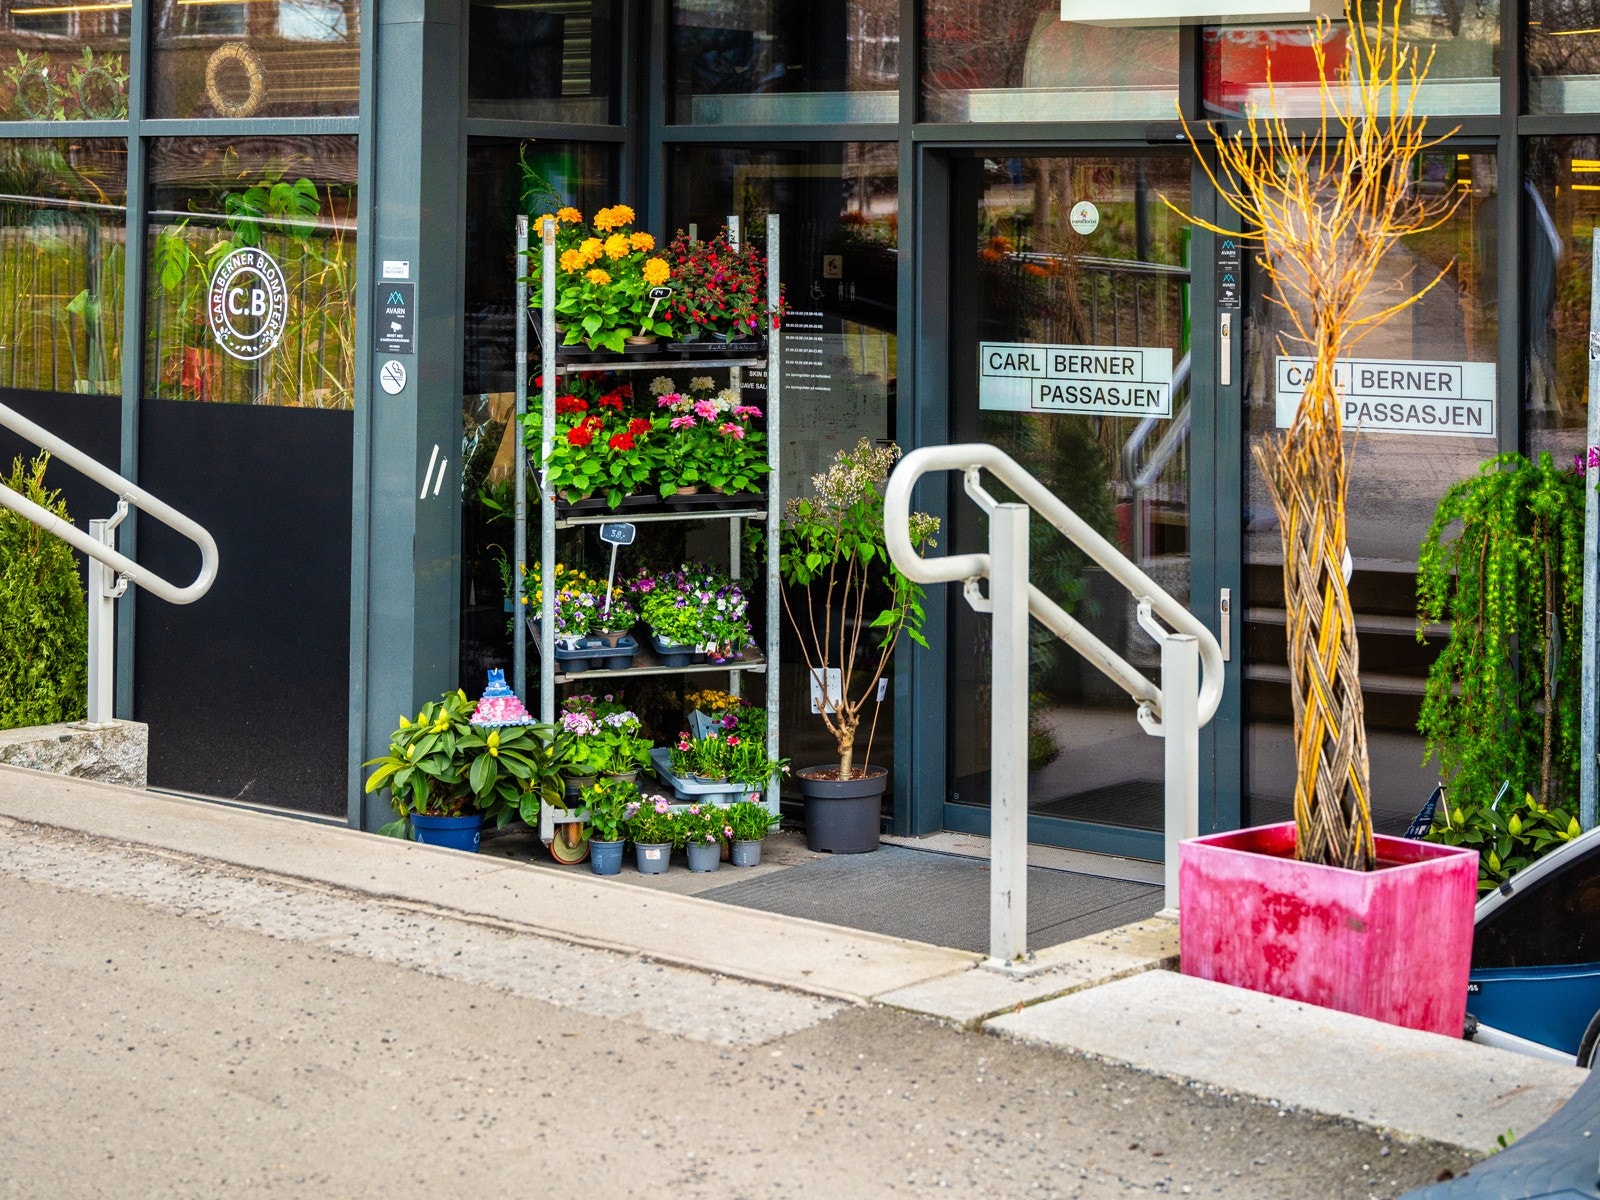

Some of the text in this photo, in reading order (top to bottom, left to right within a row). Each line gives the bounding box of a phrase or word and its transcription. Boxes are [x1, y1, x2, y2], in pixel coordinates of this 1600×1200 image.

[228, 287, 266, 316] C.B
[256, 257, 283, 330] BLOMSTER
[989, 352, 1135, 375] CARL BERNER
[1286, 367, 1453, 392] CAL BERNER
[1040, 385, 1160, 408] PASSASJEN
[1345, 401, 1483, 427] PASSASJEN
